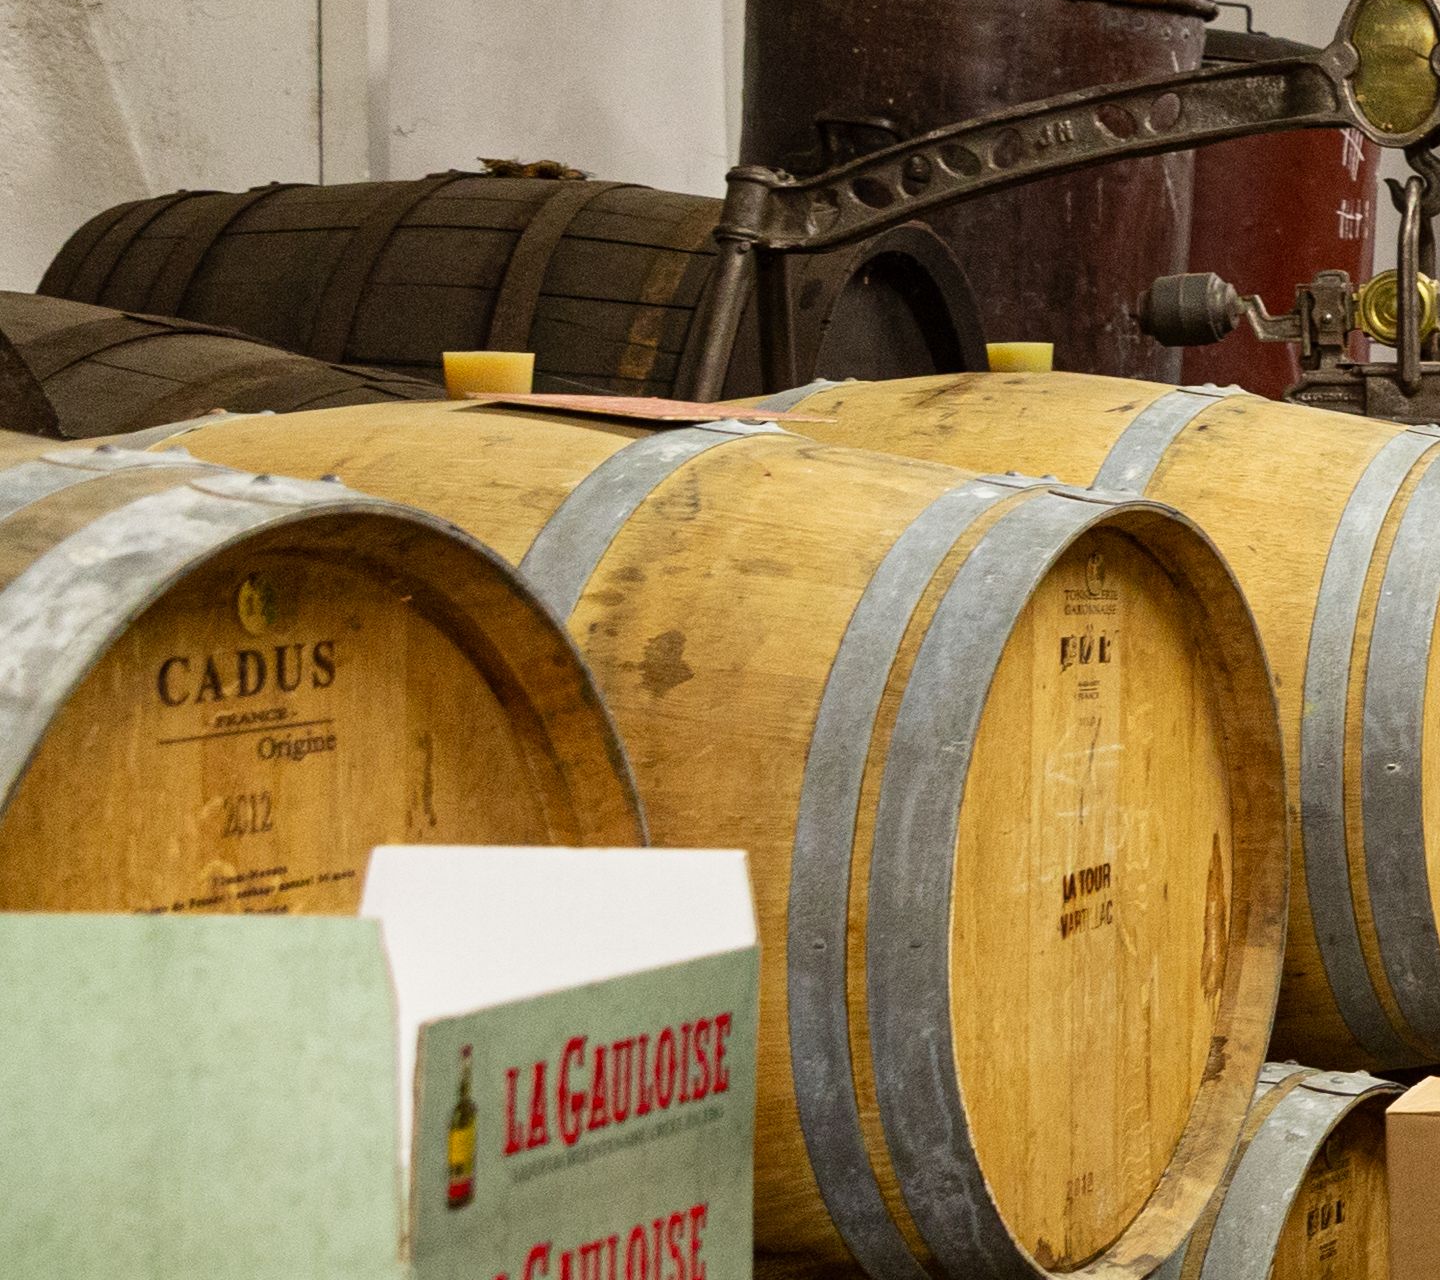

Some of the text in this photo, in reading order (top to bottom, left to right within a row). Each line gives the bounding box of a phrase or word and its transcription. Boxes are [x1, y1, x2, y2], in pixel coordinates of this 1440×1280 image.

[156, 640, 338, 708] CADUS
[256, 732, 338, 761] Origine
[1079, 862, 1111, 896] TOUR
[502, 1061, 549, 1156] LA
[555, 1012, 731, 1147] GAULOISE
